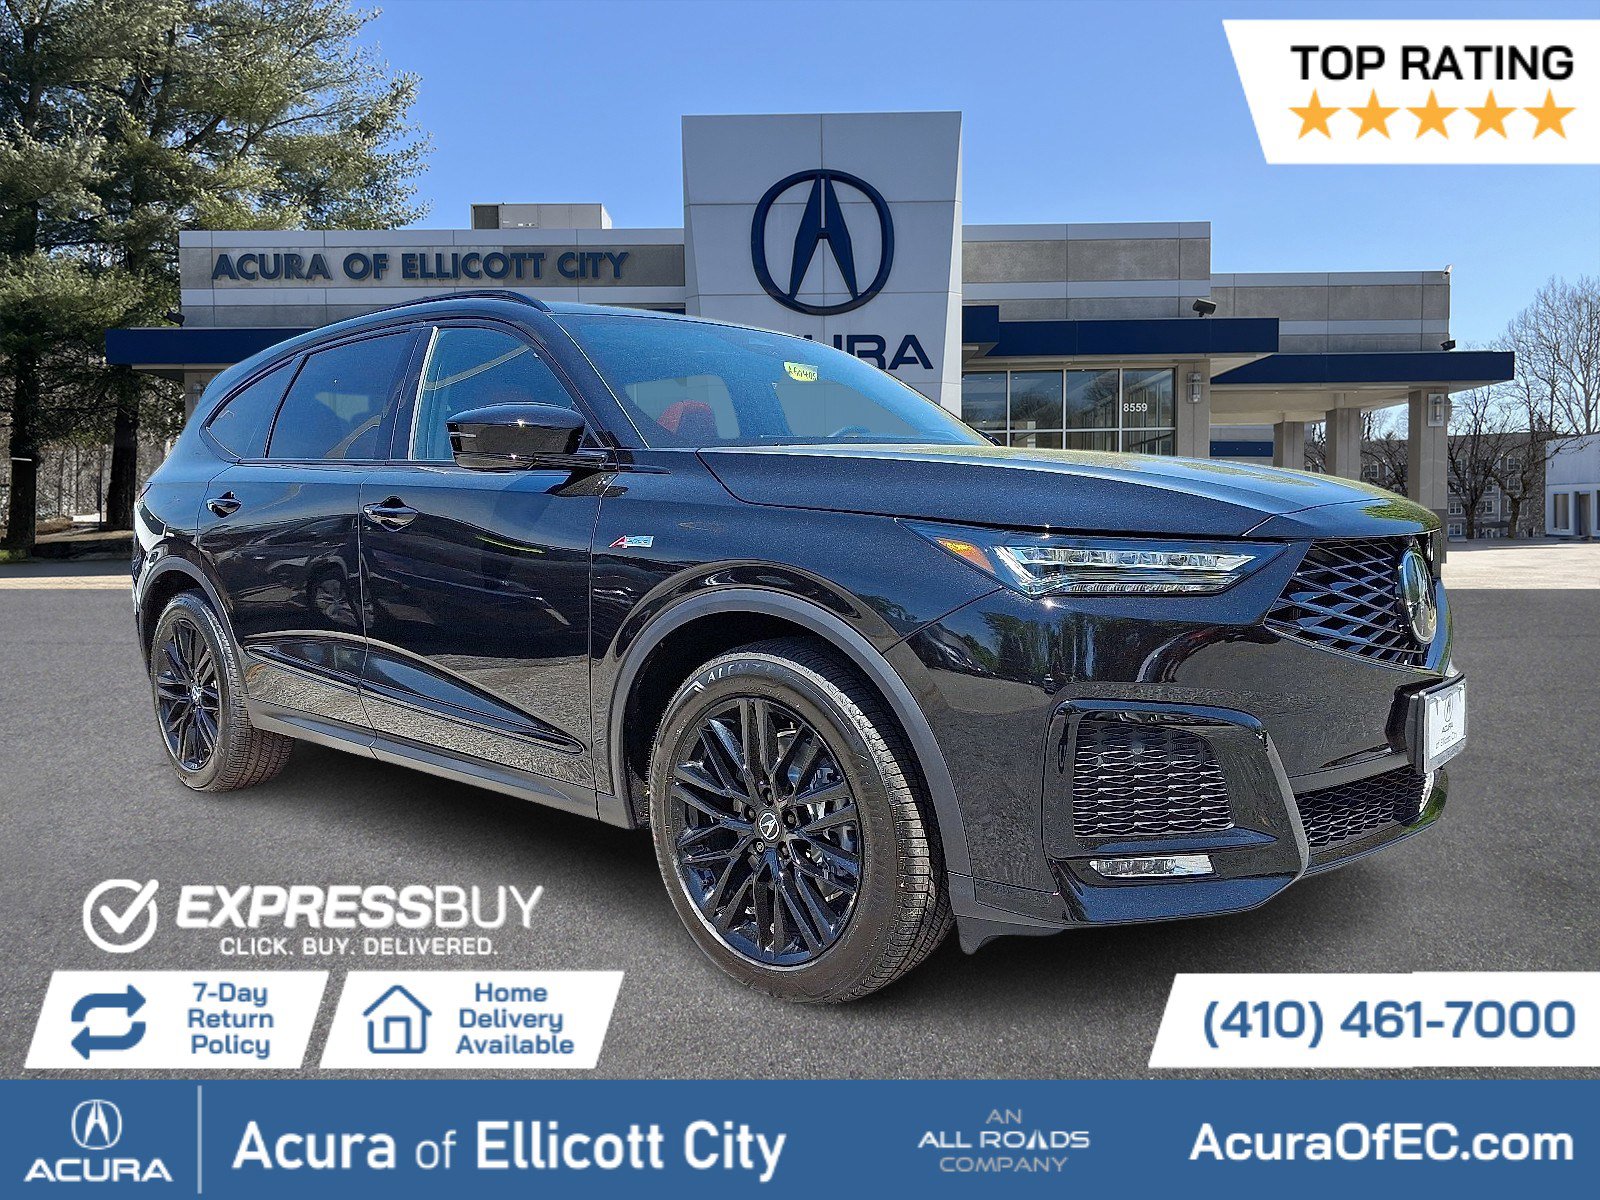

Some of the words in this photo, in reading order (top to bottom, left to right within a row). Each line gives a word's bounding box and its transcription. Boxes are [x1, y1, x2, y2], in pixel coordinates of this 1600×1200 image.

[211, 253, 332, 281] ACURA
[342, 252, 389, 280] OF
[401, 252, 546, 280] ELLICOTT
[557, 251, 628, 280] CITY
[1123, 402, 1148, 412] 8559
